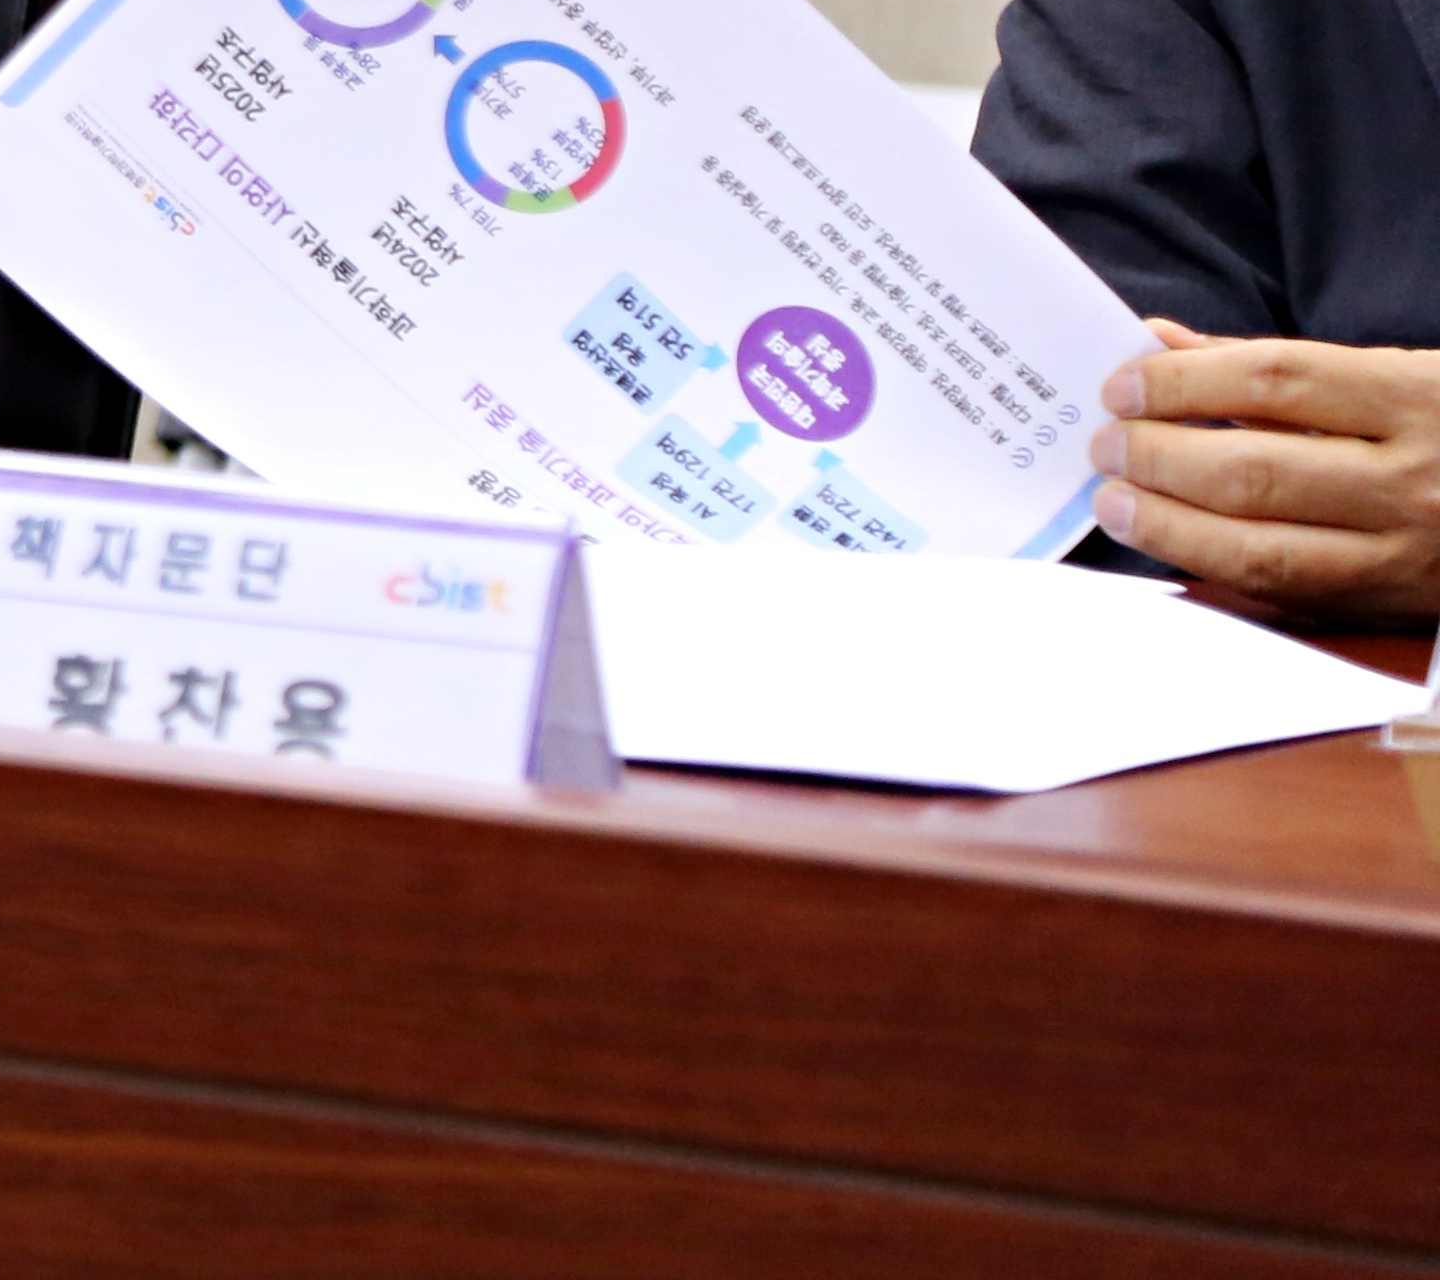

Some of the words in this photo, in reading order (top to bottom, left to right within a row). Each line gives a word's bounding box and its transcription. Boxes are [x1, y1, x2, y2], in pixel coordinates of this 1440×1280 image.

[214, 26, 293, 100] 사업구조
[345, 40, 381, 75] 28%
[580, 18, 628, 62] 산업부
[194, 53, 266, 122] 2025년
[491, 66, 526, 100] 57%
[148, 87, 224, 162] 다각화
[574, 116, 610, 149] 23%
[218, 154, 296, 226] 사업의
[530, 147, 563, 181] 13%
[370, 220, 440, 287] 2024년
[390, 194, 466, 266] 사업구조
[289, 220, 416, 341] 과학기술혁신
[616, 286, 662, 331] 51억
[657, 324, 694, 361] 5건
[766, 330, 851, 411] 과학기술의
[462, 382, 517, 432] 중심
[748, 362, 818, 429] 대한민국
[516, 428, 617, 508] 과학기술
[655, 432, 710, 480] 129억
[710, 476, 756, 514] 17건
